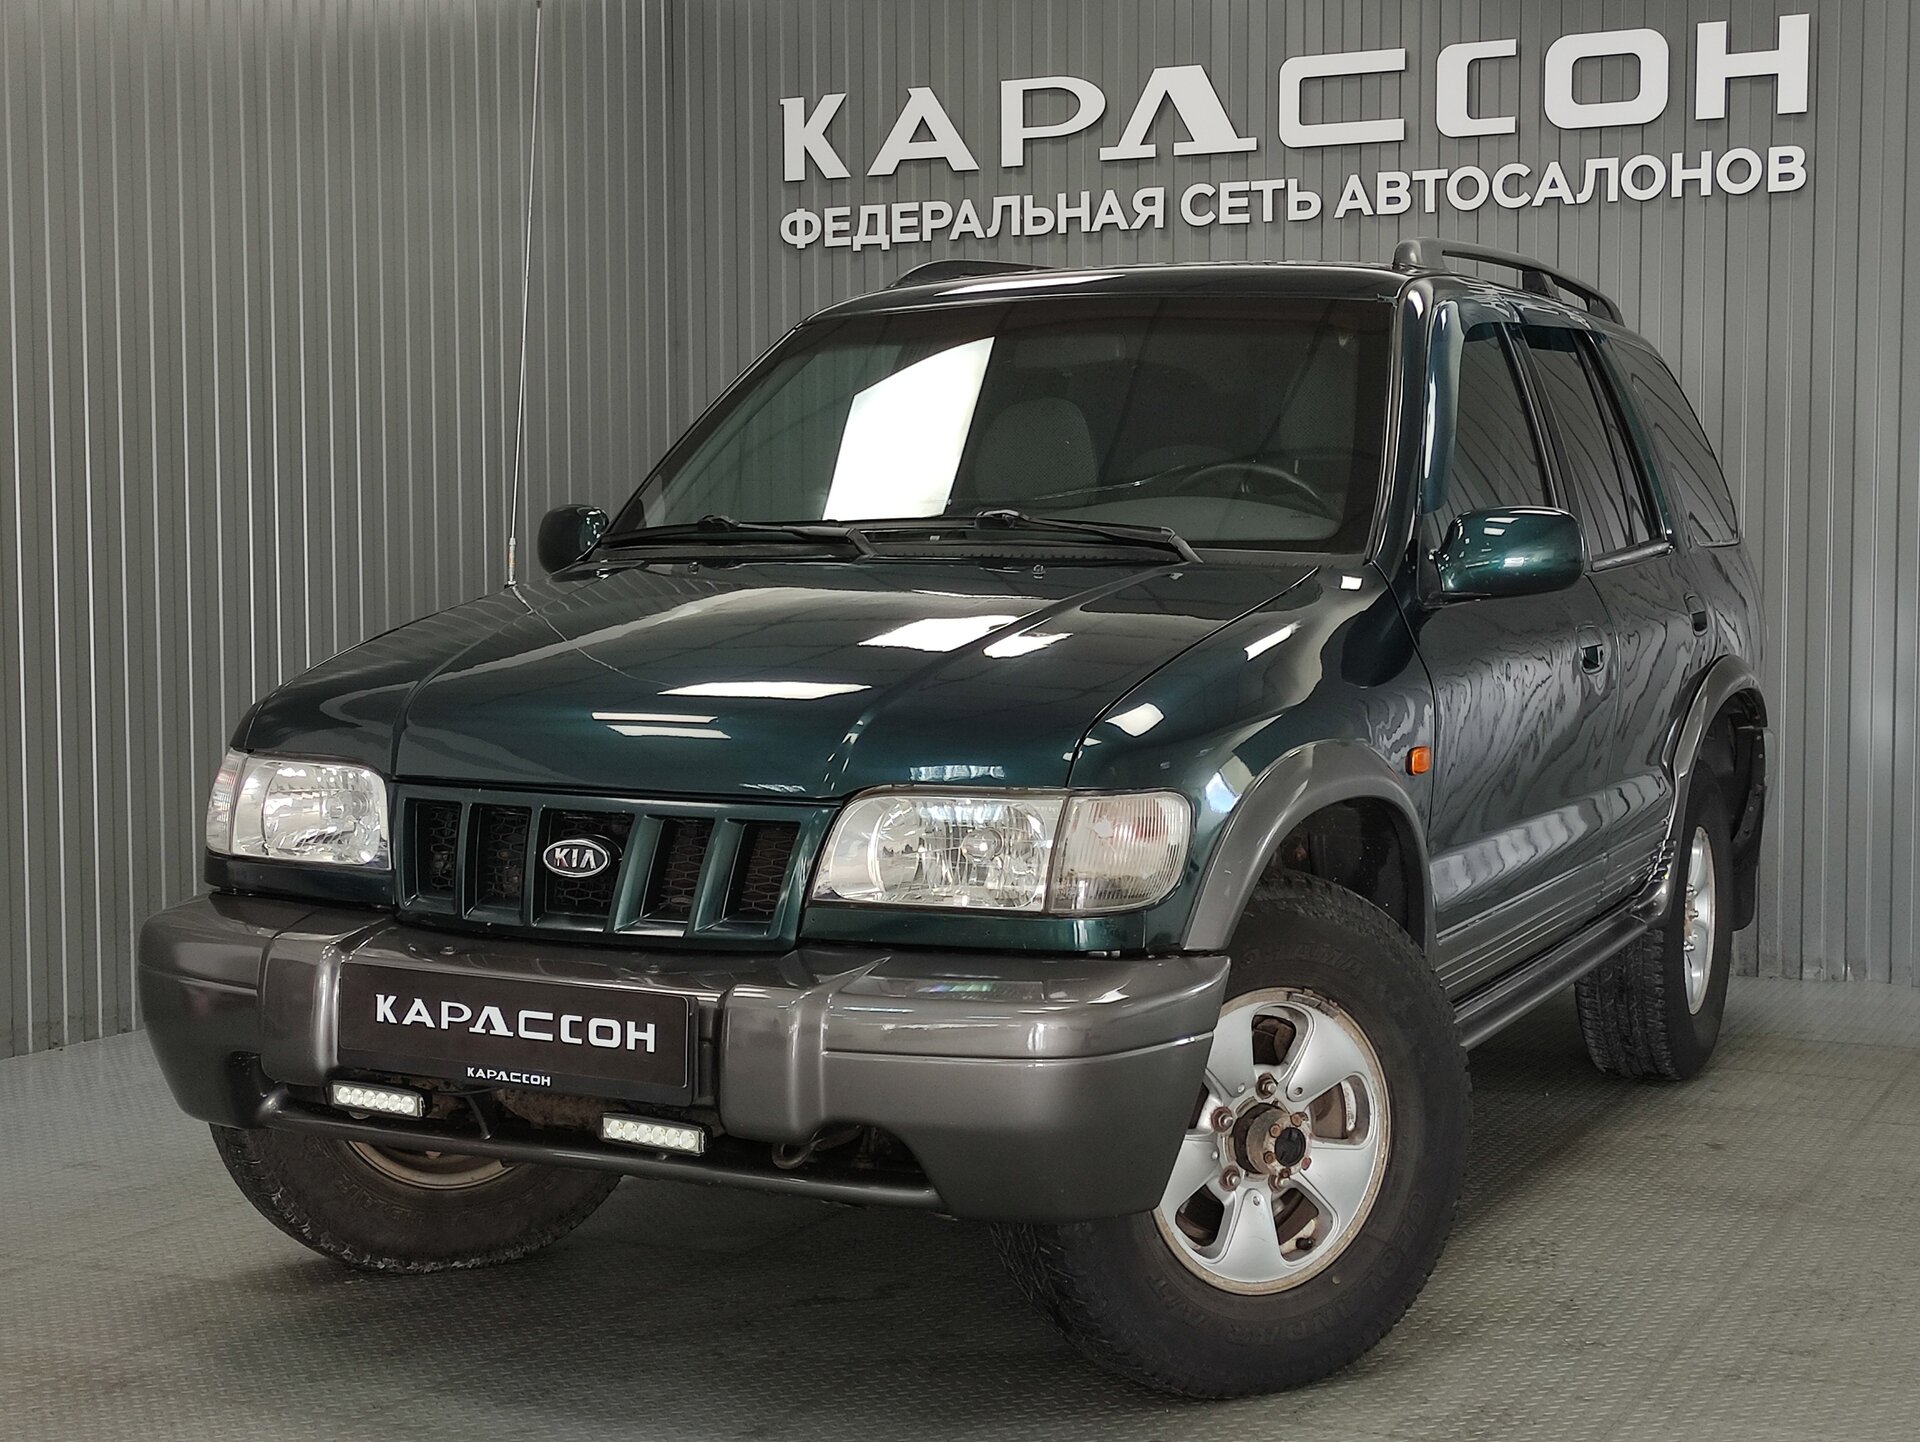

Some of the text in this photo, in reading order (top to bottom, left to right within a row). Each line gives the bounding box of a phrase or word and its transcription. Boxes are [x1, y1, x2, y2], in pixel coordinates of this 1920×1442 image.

[780, 146, 1807, 251] ФЕДЕРАЛЬНАЯ СЕТЬ АВТОСАЛОНОВ
[554, 847, 597, 869] KIA
